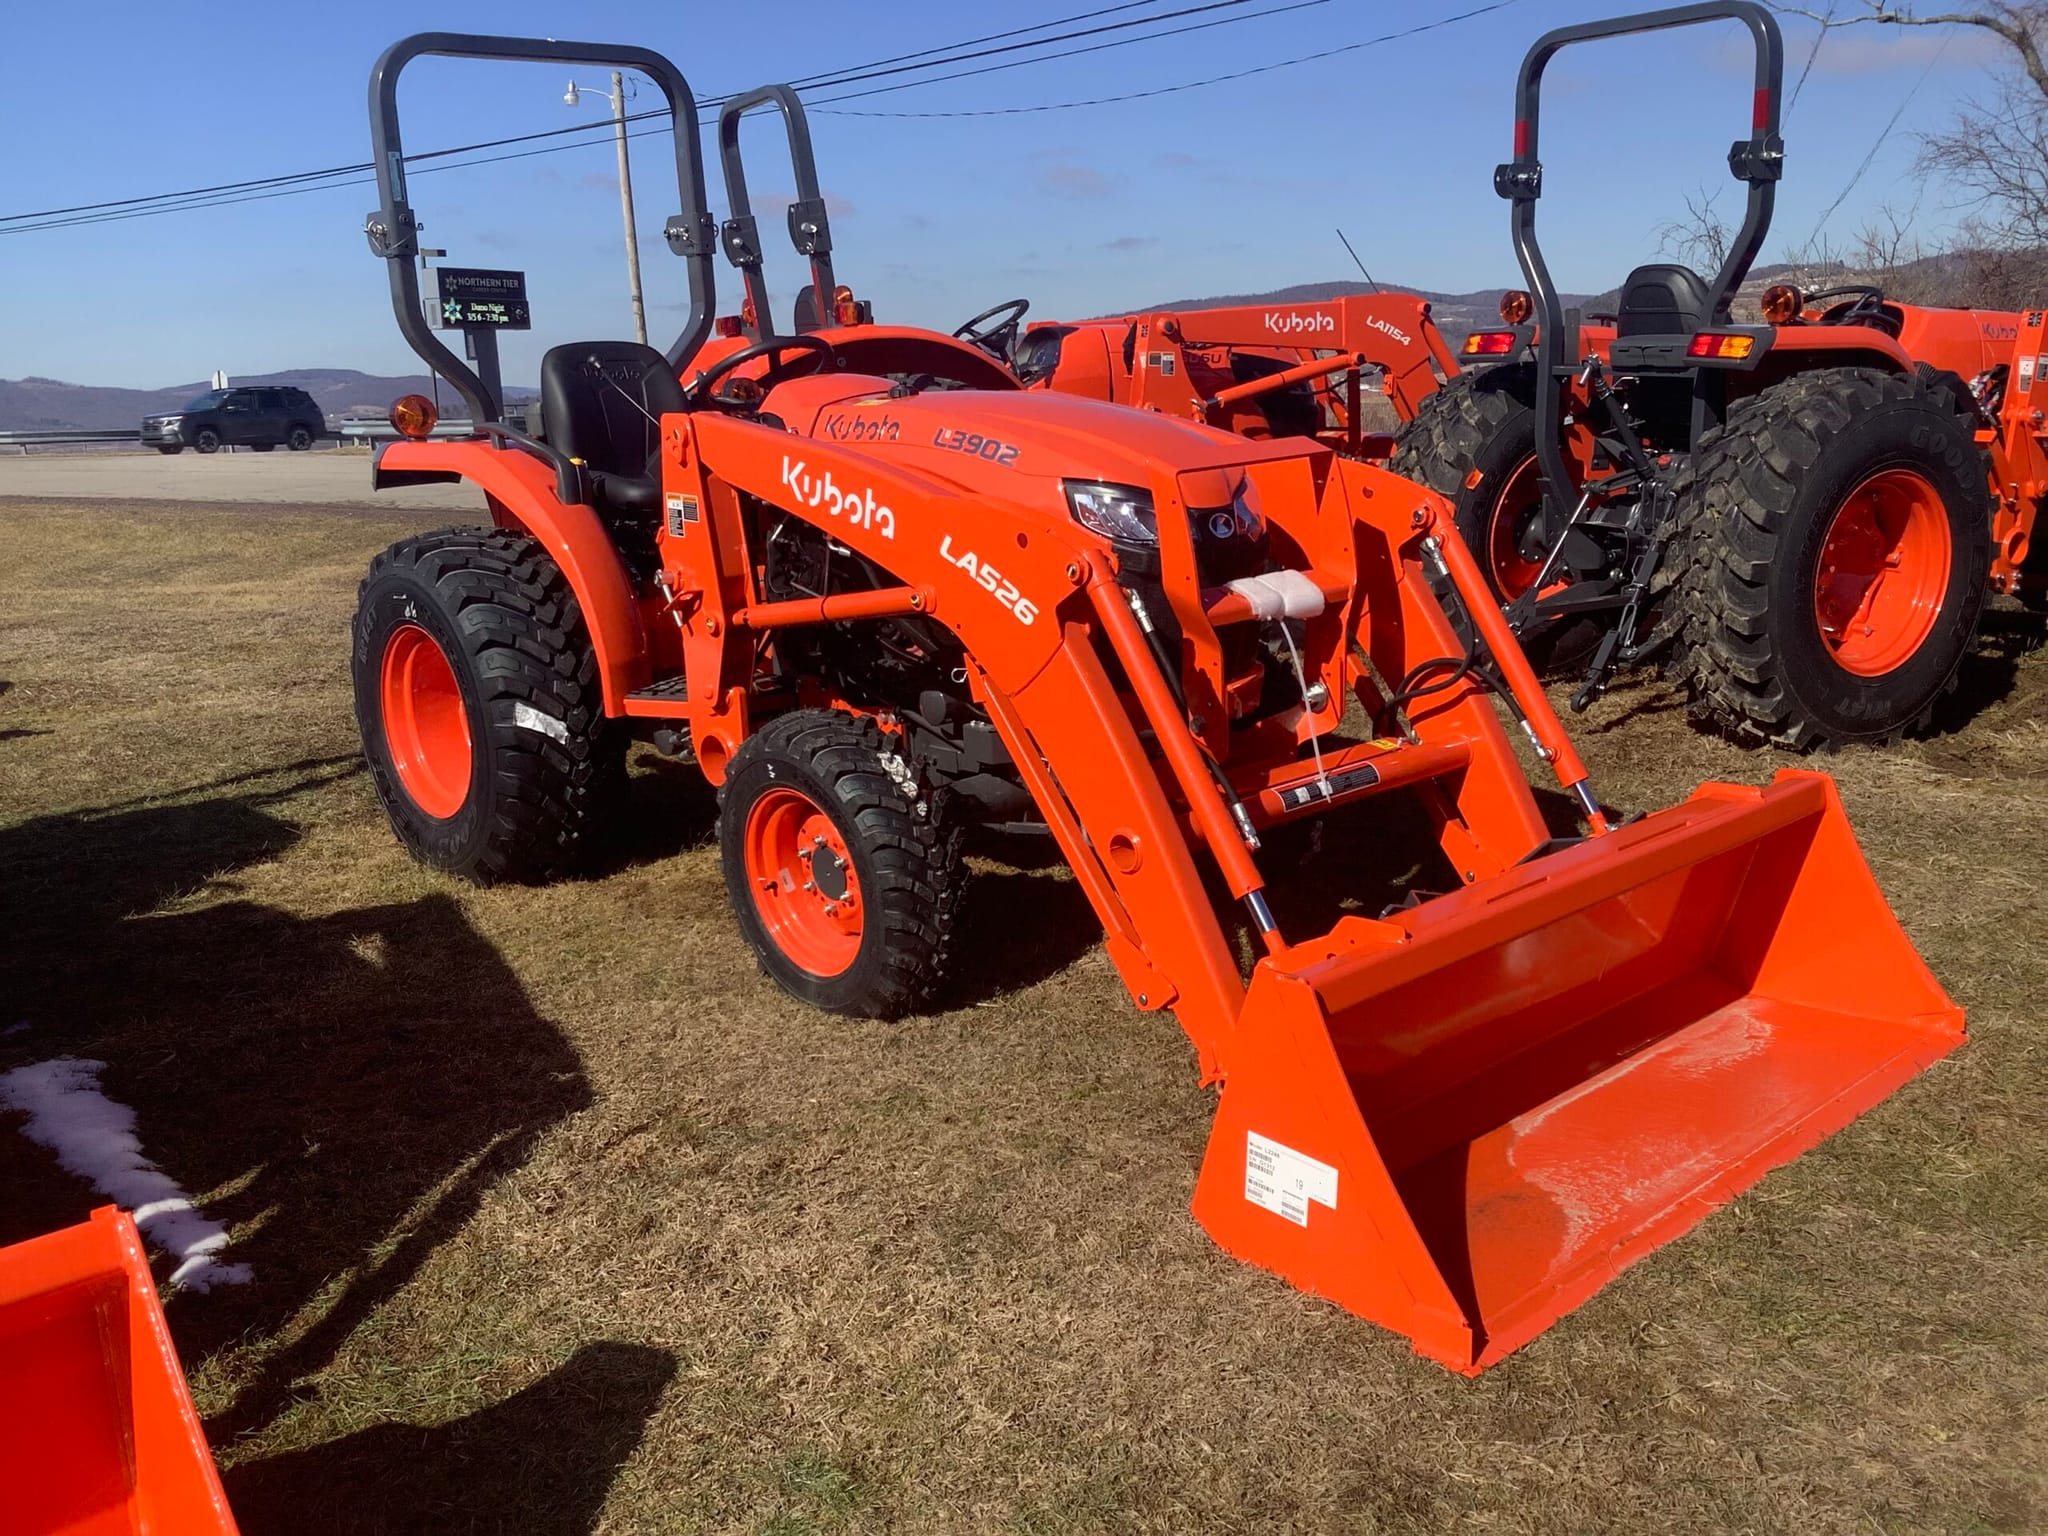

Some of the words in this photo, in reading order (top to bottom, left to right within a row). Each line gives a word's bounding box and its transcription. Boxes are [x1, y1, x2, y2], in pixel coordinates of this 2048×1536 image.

[458, 277, 501, 287] NORTHERN
[502, 279, 519, 288] TIER
[488, 303, 505, 314] Night
[1264, 310, 1335, 333] Kubota
[1366, 315, 1411, 346] LA1154
[824, 413, 900, 441] Kubota
[933, 427, 1021, 467] L3902
[781, 455, 895, 540] Kubota
[939, 534, 1040, 626] LA526
[1295, 1178, 1304, 1190] 19
